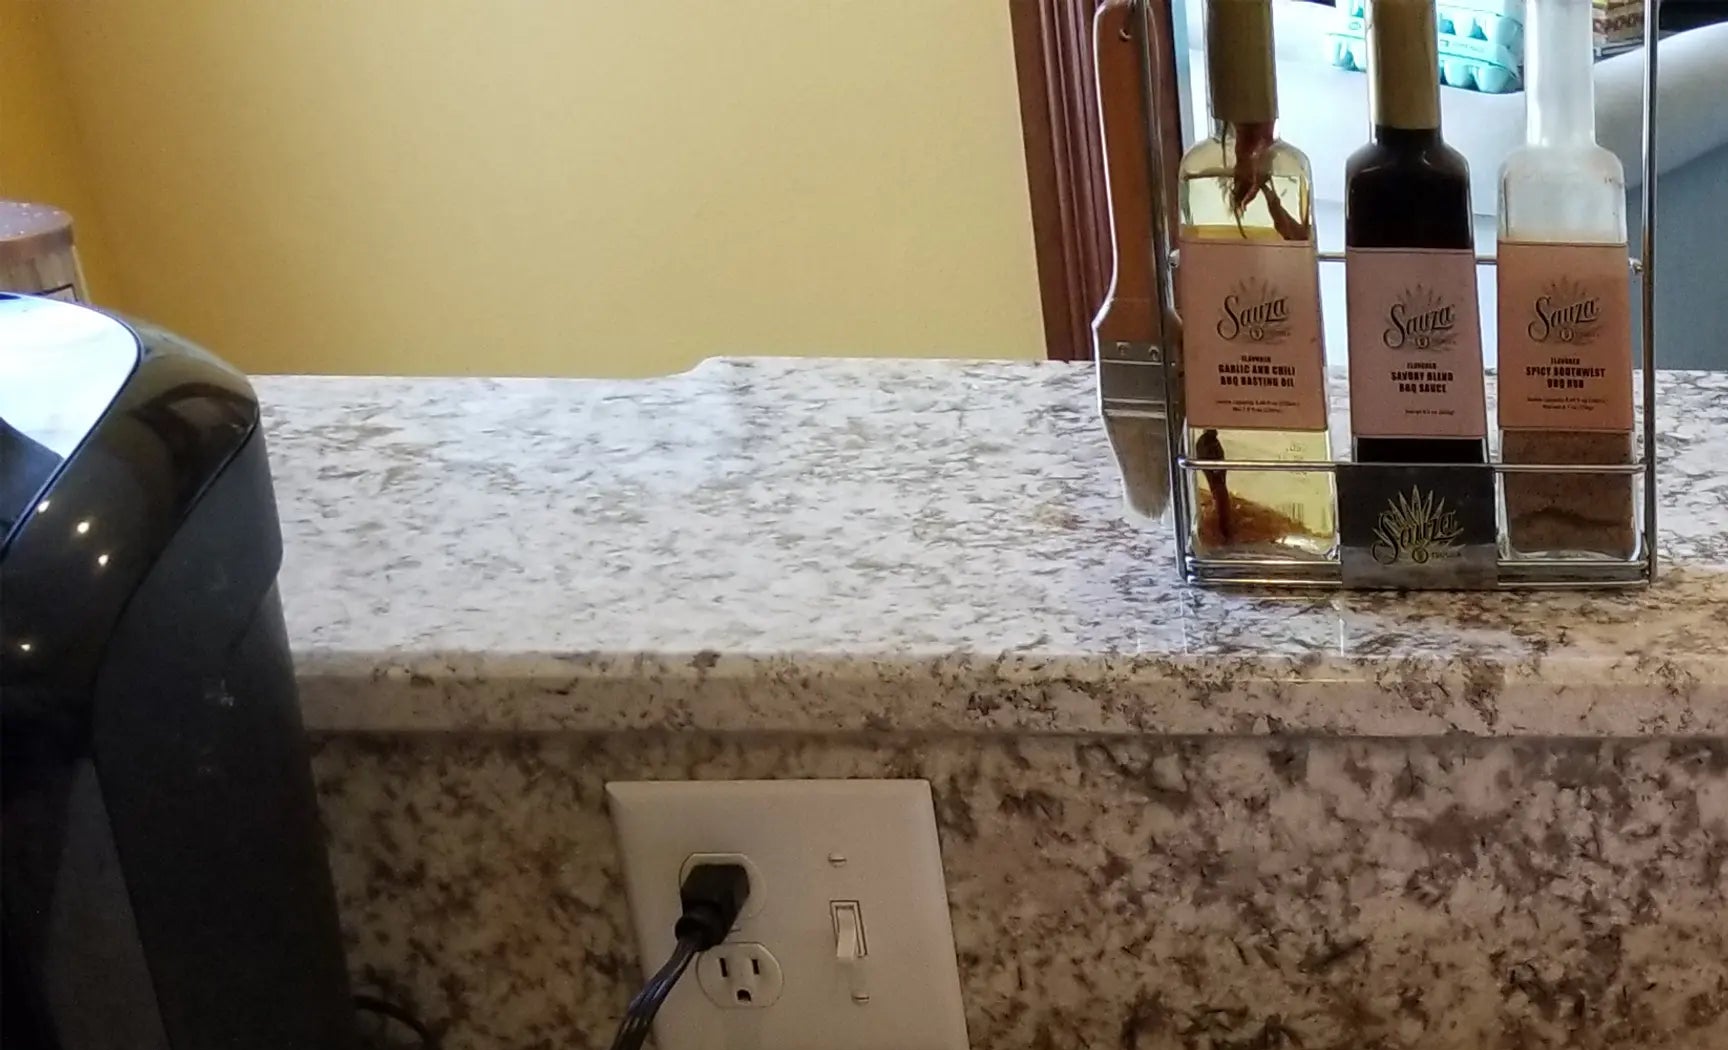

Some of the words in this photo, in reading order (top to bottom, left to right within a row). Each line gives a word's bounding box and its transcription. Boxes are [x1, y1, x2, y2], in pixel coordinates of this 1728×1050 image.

[1216, 295, 1289, 341] Sauza
[1528, 295, 1600, 342] Sauza
[1383, 303, 1455, 349] Sauza
[1218, 364, 1250, 374] GARLIC
[1252, 365, 1270, 374] AND
[1272, 366, 1296, 376] CHILI
[1526, 366, 1551, 377] SPICY
[1553, 366, 1606, 378] SOUTHWEST
[1280, 377, 1295, 388] OIL
[1391, 371, 1424, 382] SAVORY
[1426, 372, 1454, 382] BLEND
[1419, 383, 1446, 394] SAUCE
[1371, 511, 1458, 565] Sauza
